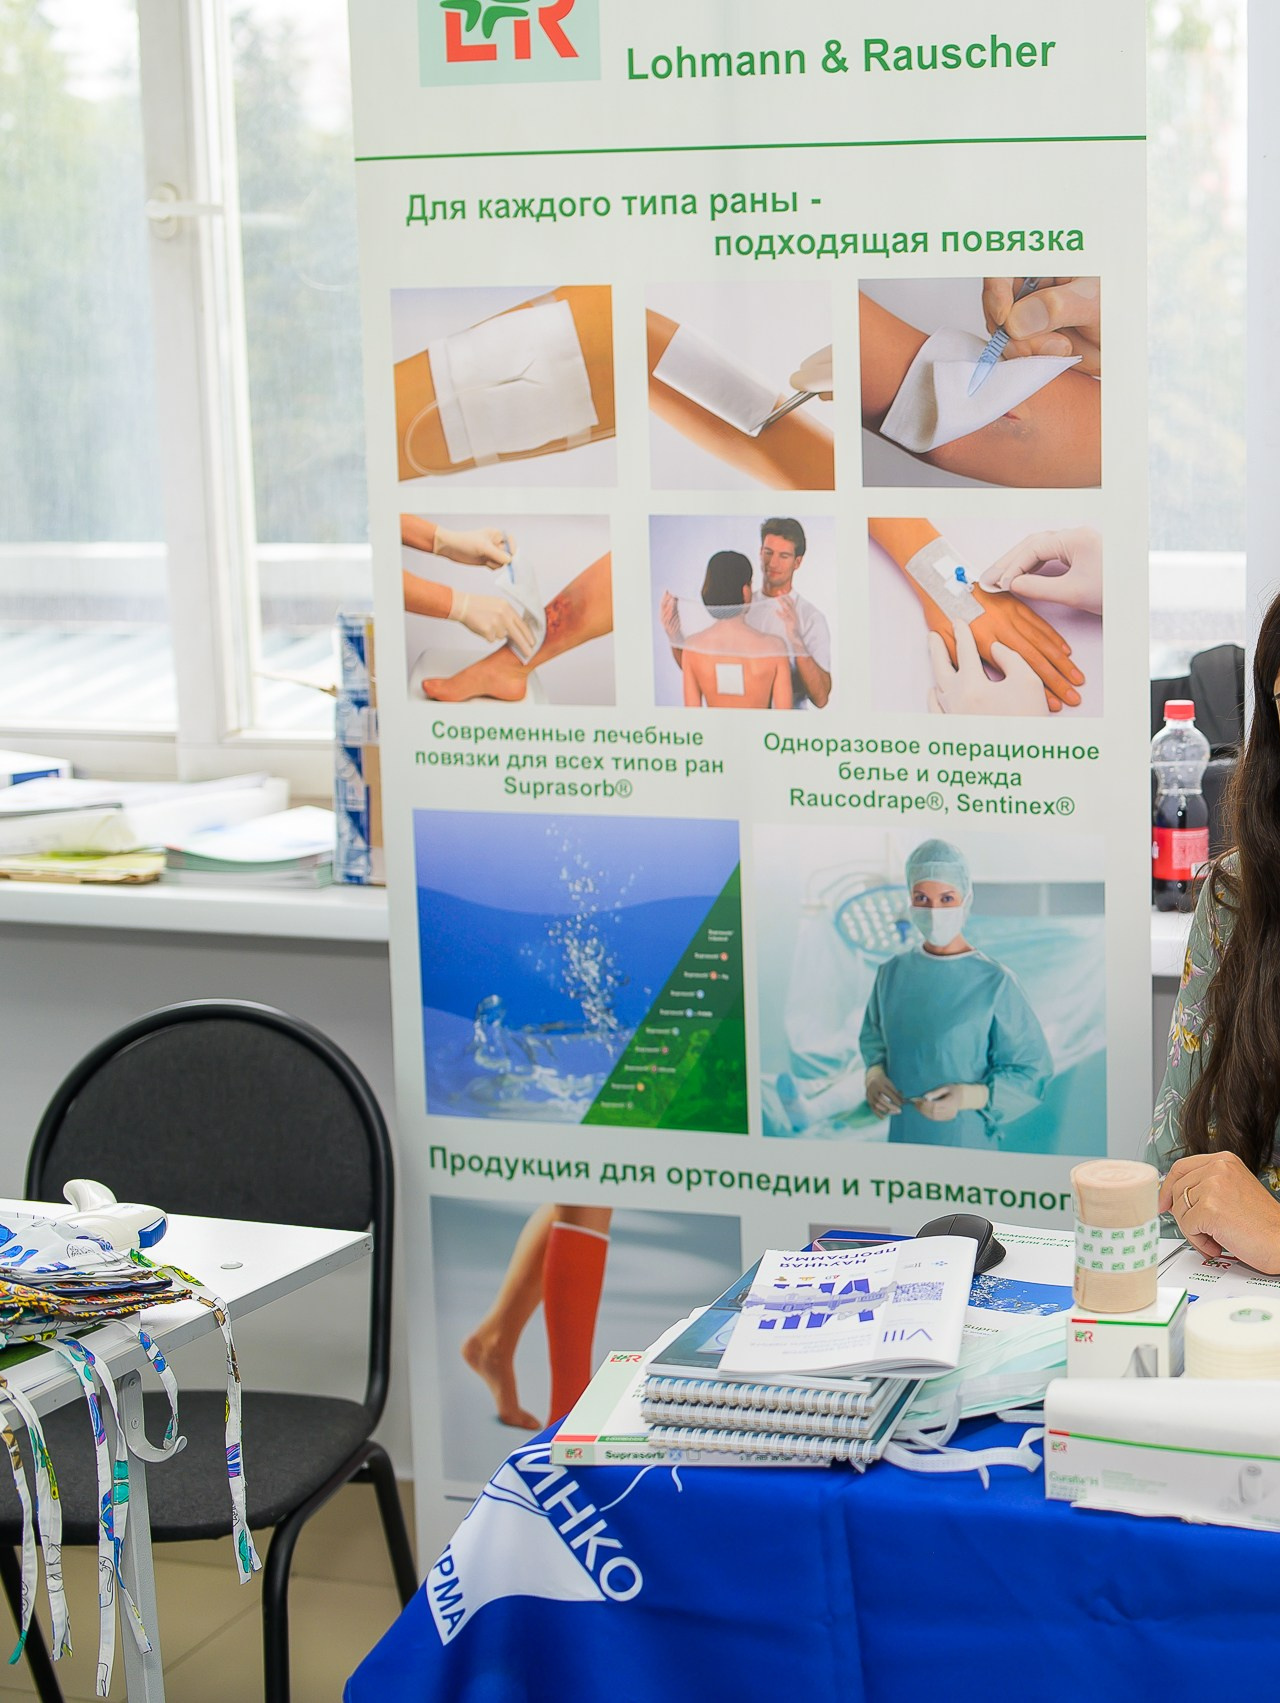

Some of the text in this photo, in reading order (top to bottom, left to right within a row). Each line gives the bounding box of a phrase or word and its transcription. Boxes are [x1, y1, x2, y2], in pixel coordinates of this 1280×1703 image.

[627, 33, 1057, 81] Lohmann & Rauscher
[405, 193, 467, 228] Для
[478, 195, 611, 223] каждого
[620, 193, 698, 216] типа
[709, 191, 798, 222] раны
[714, 229, 1085, 261] подходящая повязка
[431, 720, 704, 746] Современные лечебные
[763, 732, 1100, 762] Одноразовое операционное
[415, 748, 724, 777] повязки для всех типов ран
[838, 761, 1022, 790] белье и одежда
[429, 1145, 590, 1182] Продукция
[599, 1162, 656, 1185] для
[666, 1166, 831, 1198] ортопедии
[841, 1177, 860, 1197] и
[779, 1258, 867, 1268] НАУЧНАЯ
[783, 1247, 897, 1262] ПРОГРАММА
[513, 1444, 644, 1602] ИНКО
[432, 1543, 467, 1636] РМА
